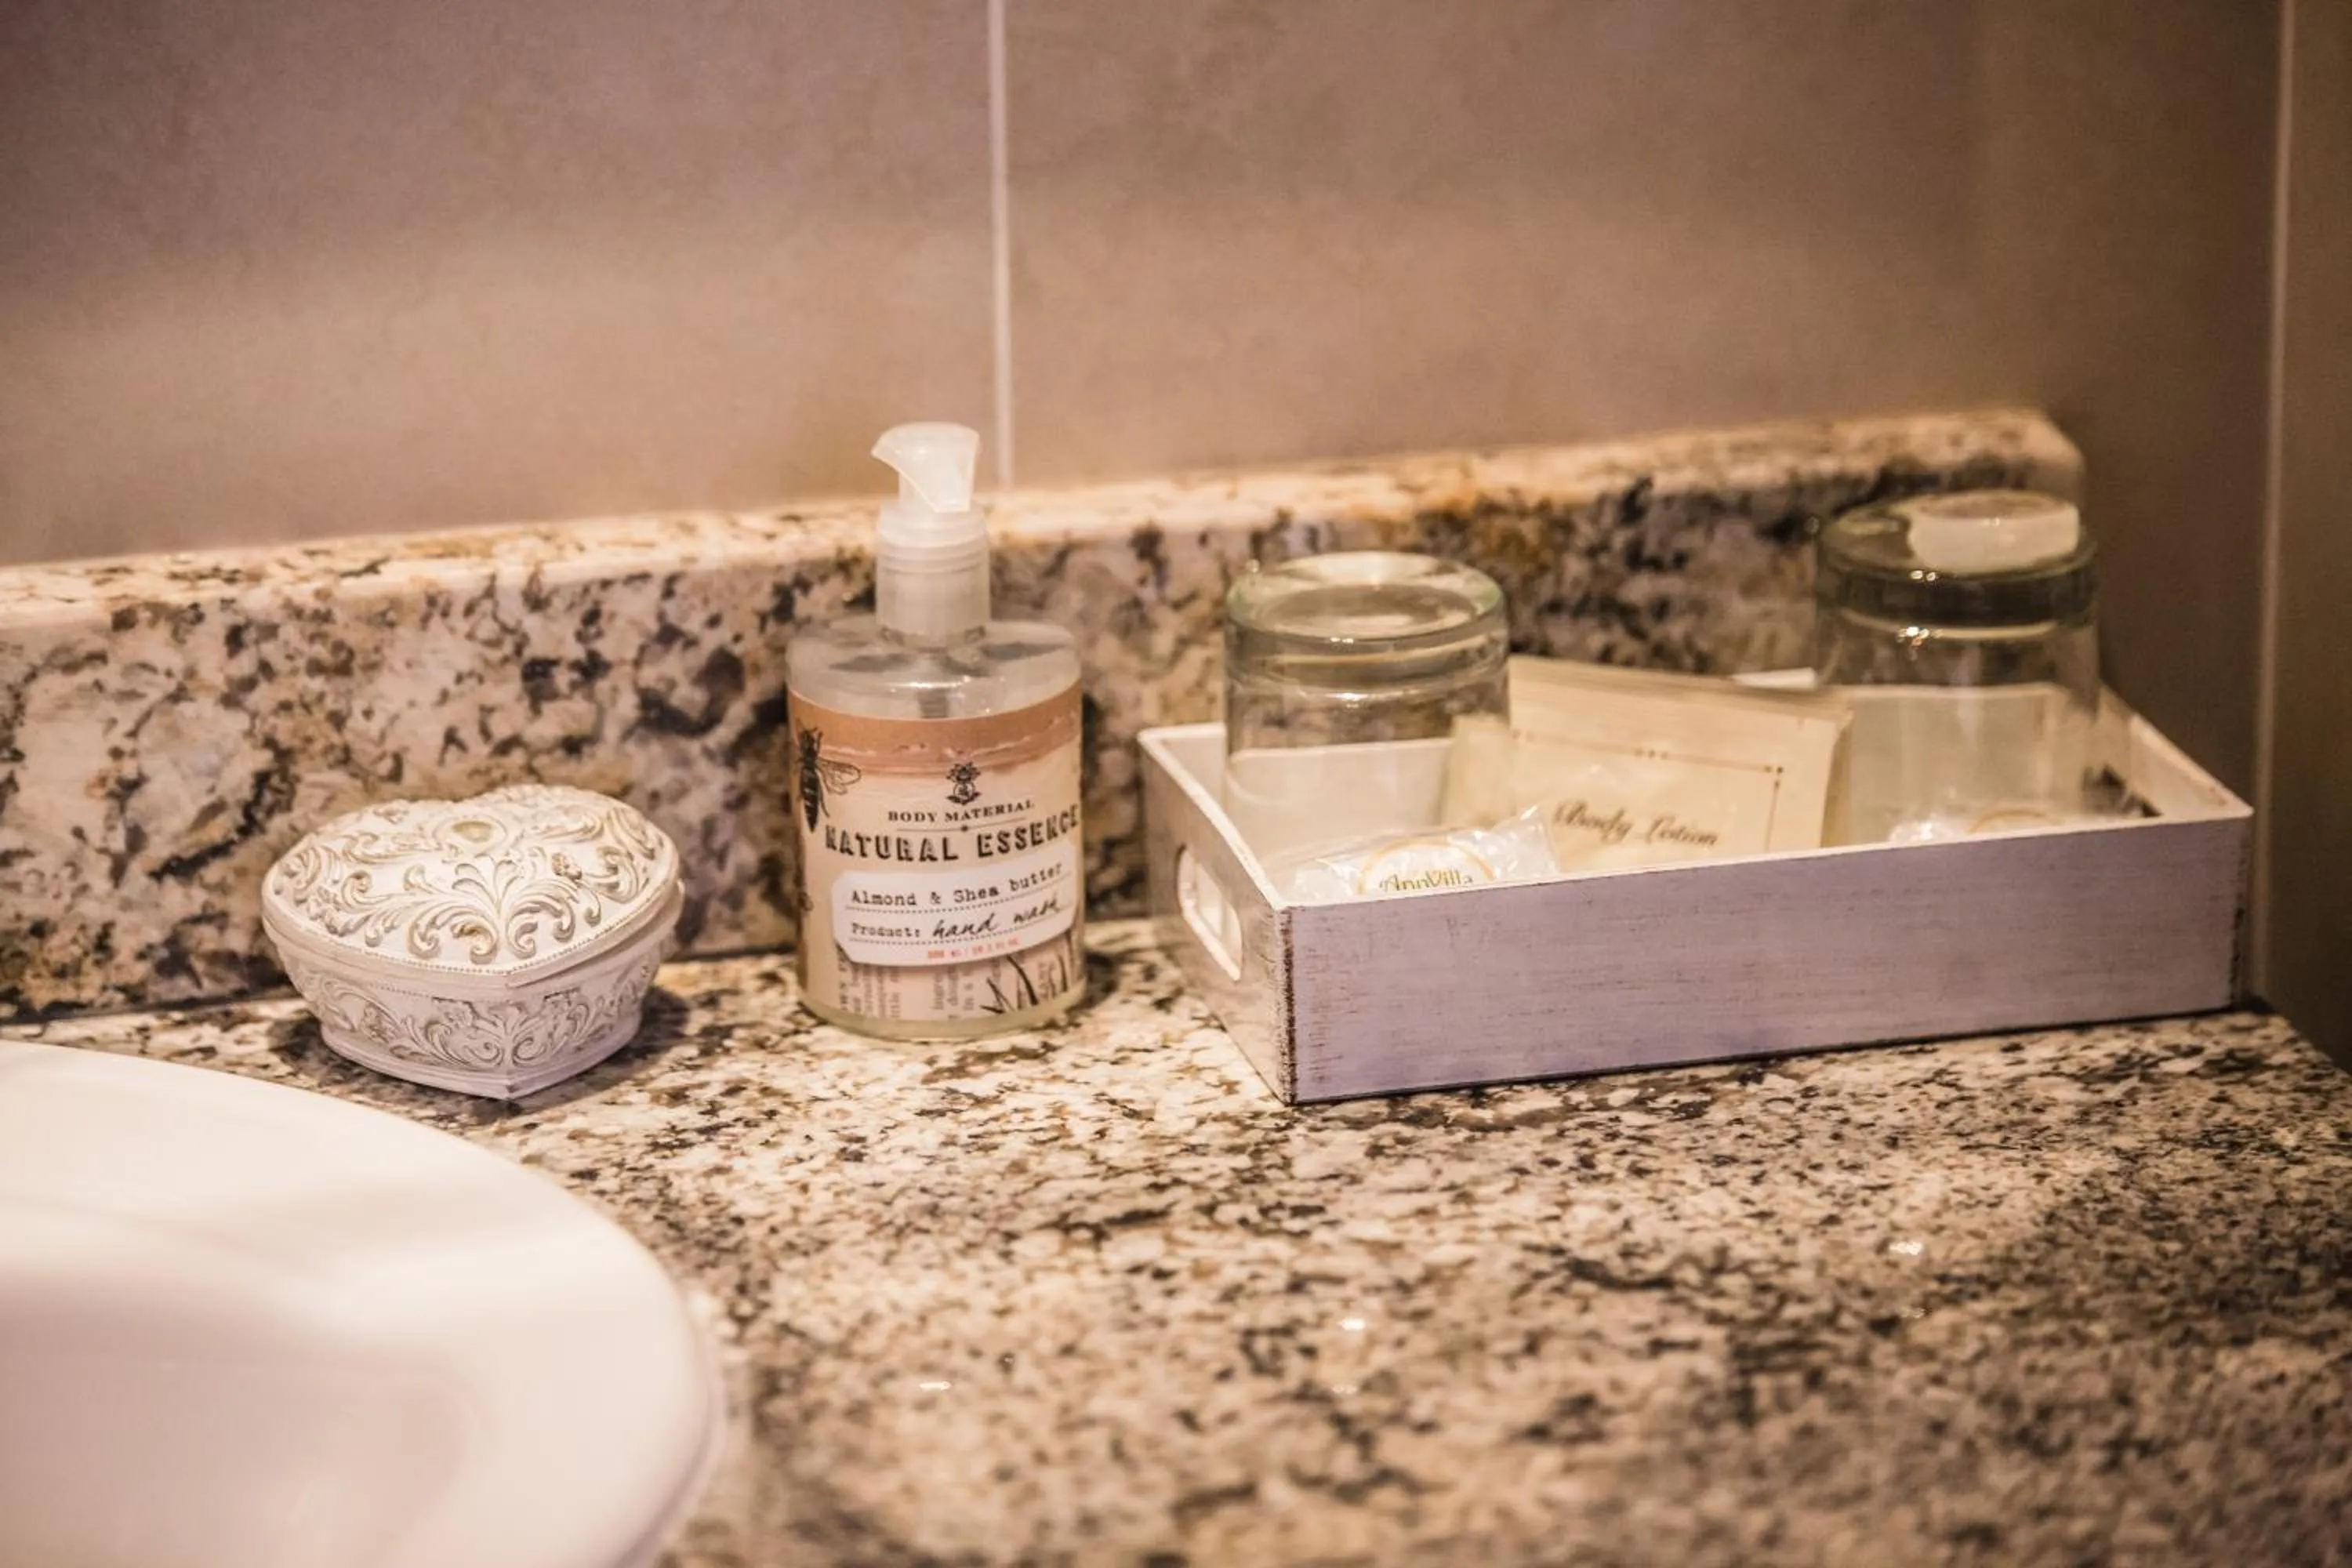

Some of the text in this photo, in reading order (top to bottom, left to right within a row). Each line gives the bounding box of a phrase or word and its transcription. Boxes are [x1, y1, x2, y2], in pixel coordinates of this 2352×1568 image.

[825, 803, 1080, 862] NATURAL ESSENCE
[887, 799, 1034, 822] BODY MATERIAL
[1552, 798, 1719, 846] Body Lotion
[851, 862, 1062, 906] Almond & Shea butter
[932, 912, 999, 939] hand
